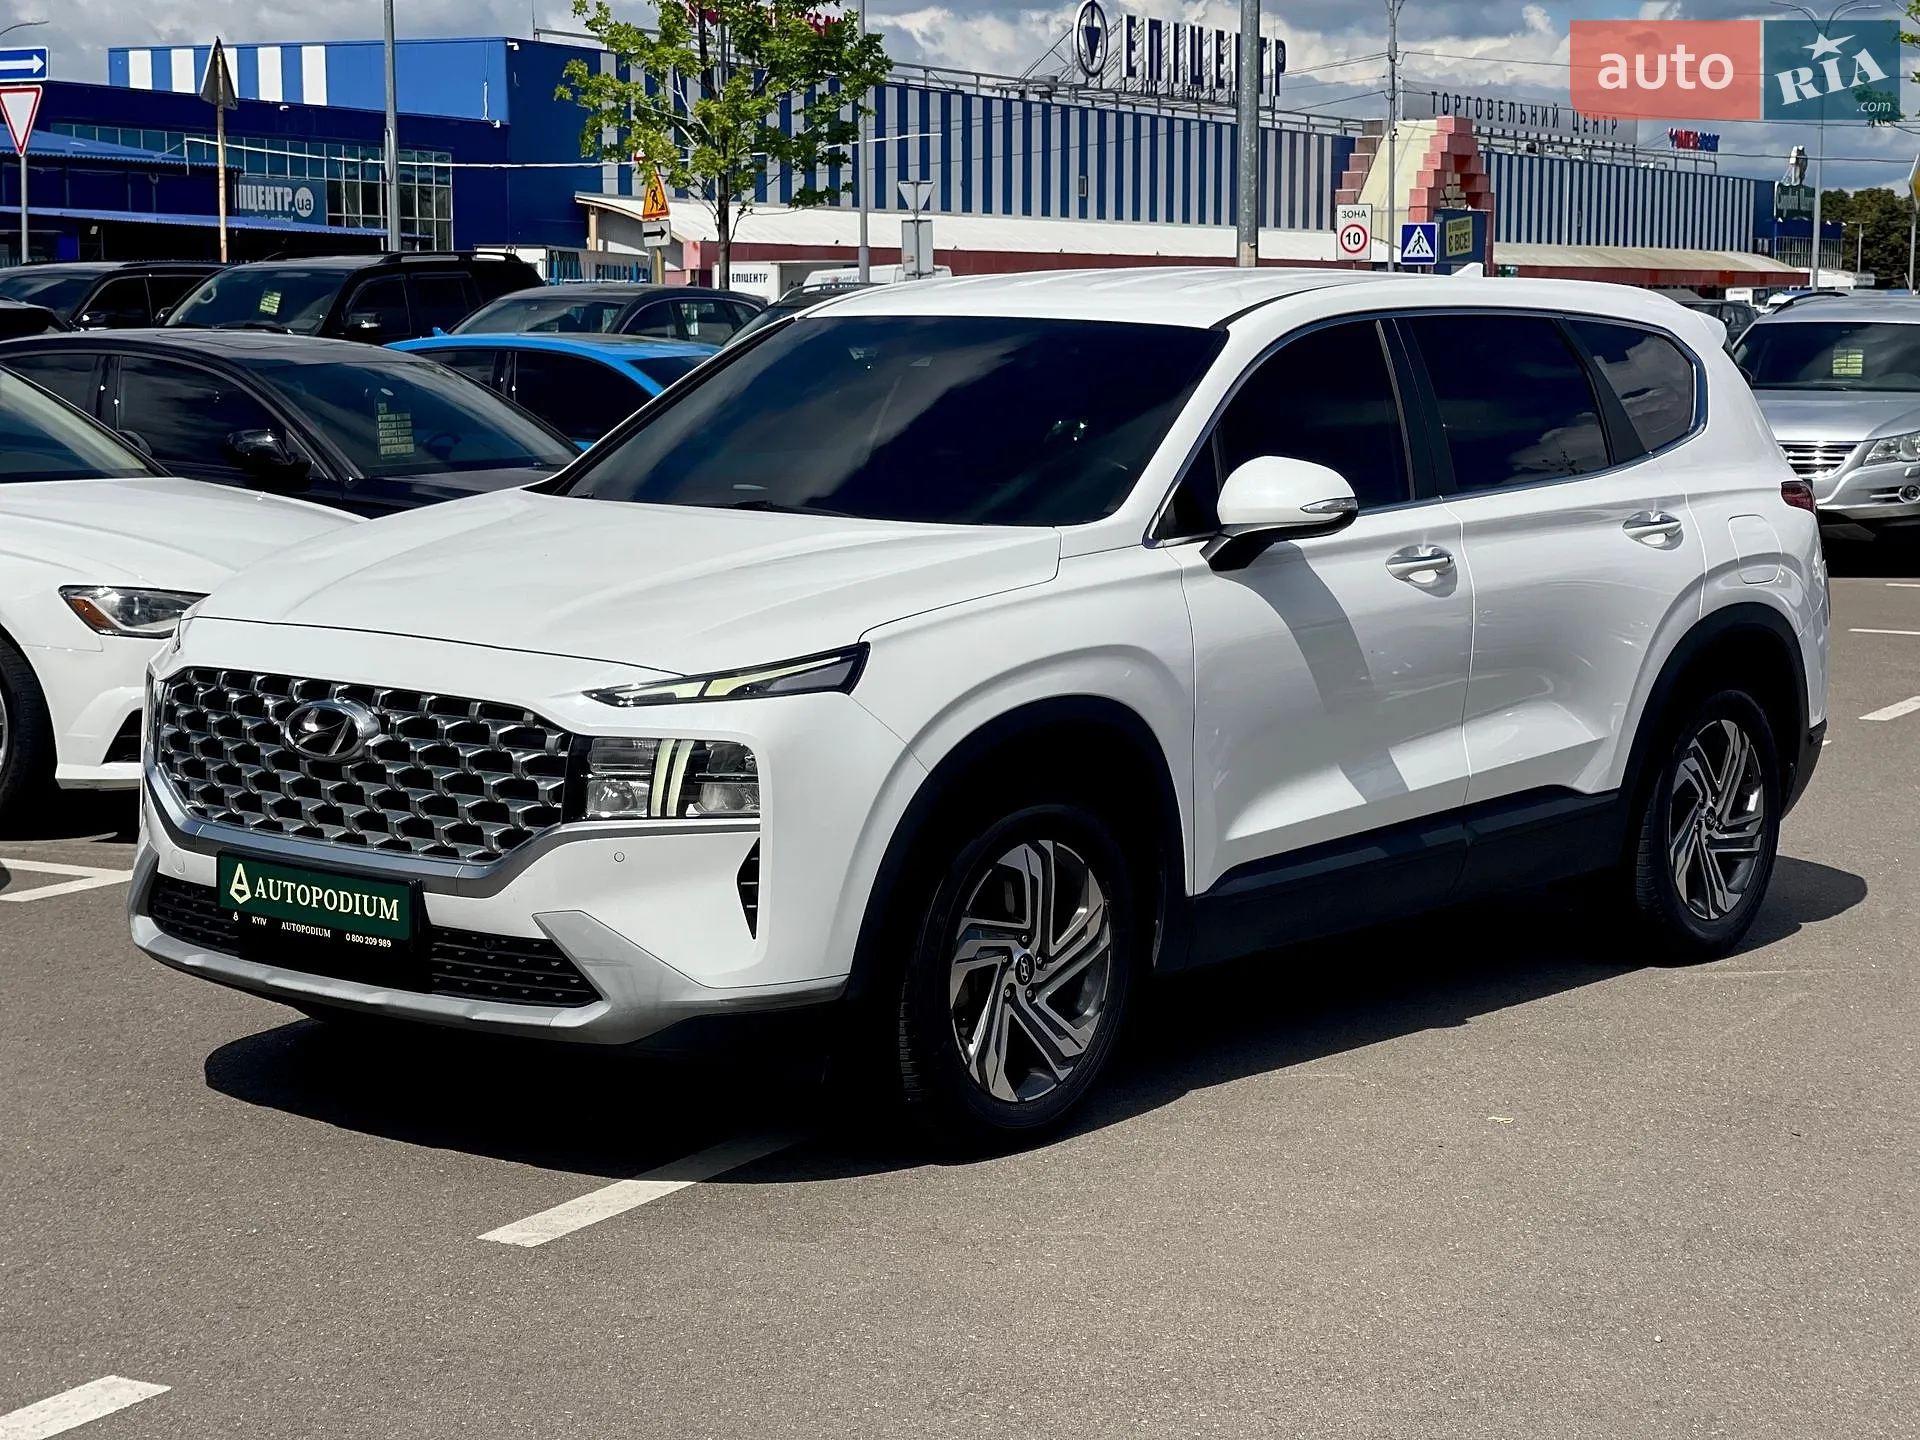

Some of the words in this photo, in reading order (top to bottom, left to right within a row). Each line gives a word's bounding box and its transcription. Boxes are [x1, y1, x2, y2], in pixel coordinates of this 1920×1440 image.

[1431, 91, 1559, 128] ТОРГОВЕЛЬНИЙ
[1572, 109, 1618, 136] ЦЕНТР
[1341, 210, 1367, 219] ЗОНА
[1345, 231, 1361, 245] 10
[731, 273, 768, 284] ЕПІЦЕНТР
[254, 876, 400, 922] AUTOPODIUM
[251, 915, 267, 926] KYIV
[281, 921, 331, 939] AUTOPODIUM
[345, 932, 351, 941] 0
[351, 934, 364, 944] 800
[364, 935, 377, 946] 209
[378, 938, 391, 948] 989
